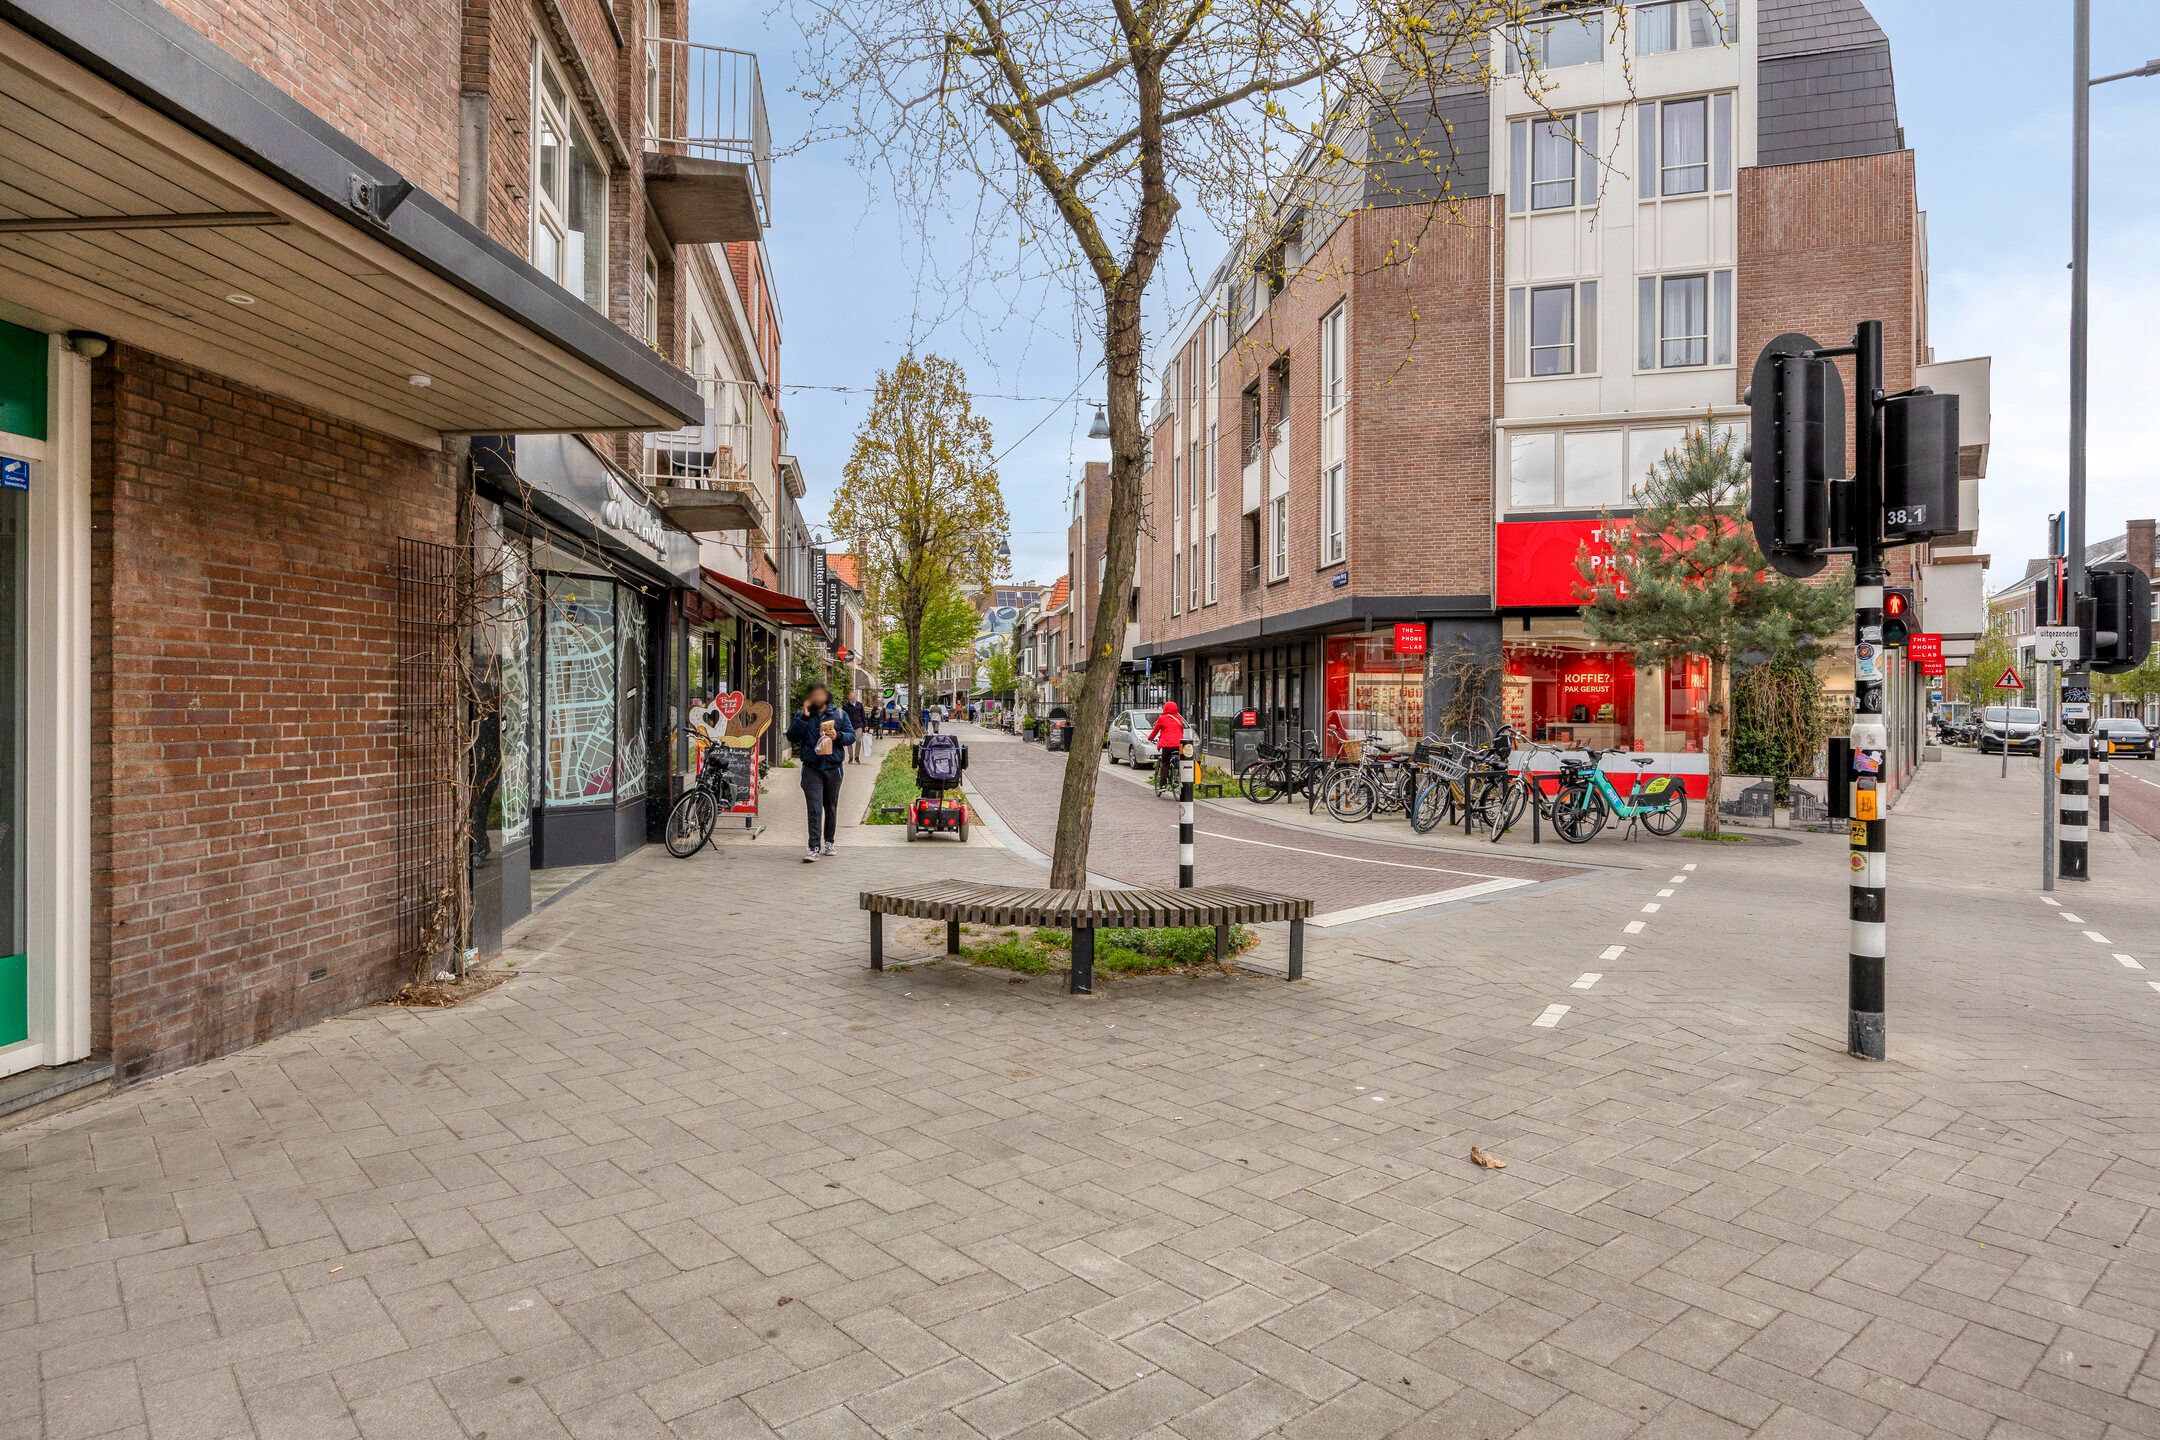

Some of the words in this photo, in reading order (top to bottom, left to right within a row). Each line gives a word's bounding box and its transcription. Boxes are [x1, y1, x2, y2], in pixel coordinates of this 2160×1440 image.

[1887, 508, 1922, 524] 38.1
[1591, 529, 1630, 543] THE
[816, 555, 825, 586] united
[830, 583, 838, 598] art
[829, 598, 838, 625] house
[2040, 630, 2079, 639] uitgezonderd
[1564, 673, 1610, 683] KOFFIE?
[1580, 685, 1610, 693] GERUST
[1606, 788, 1620, 803] dott
